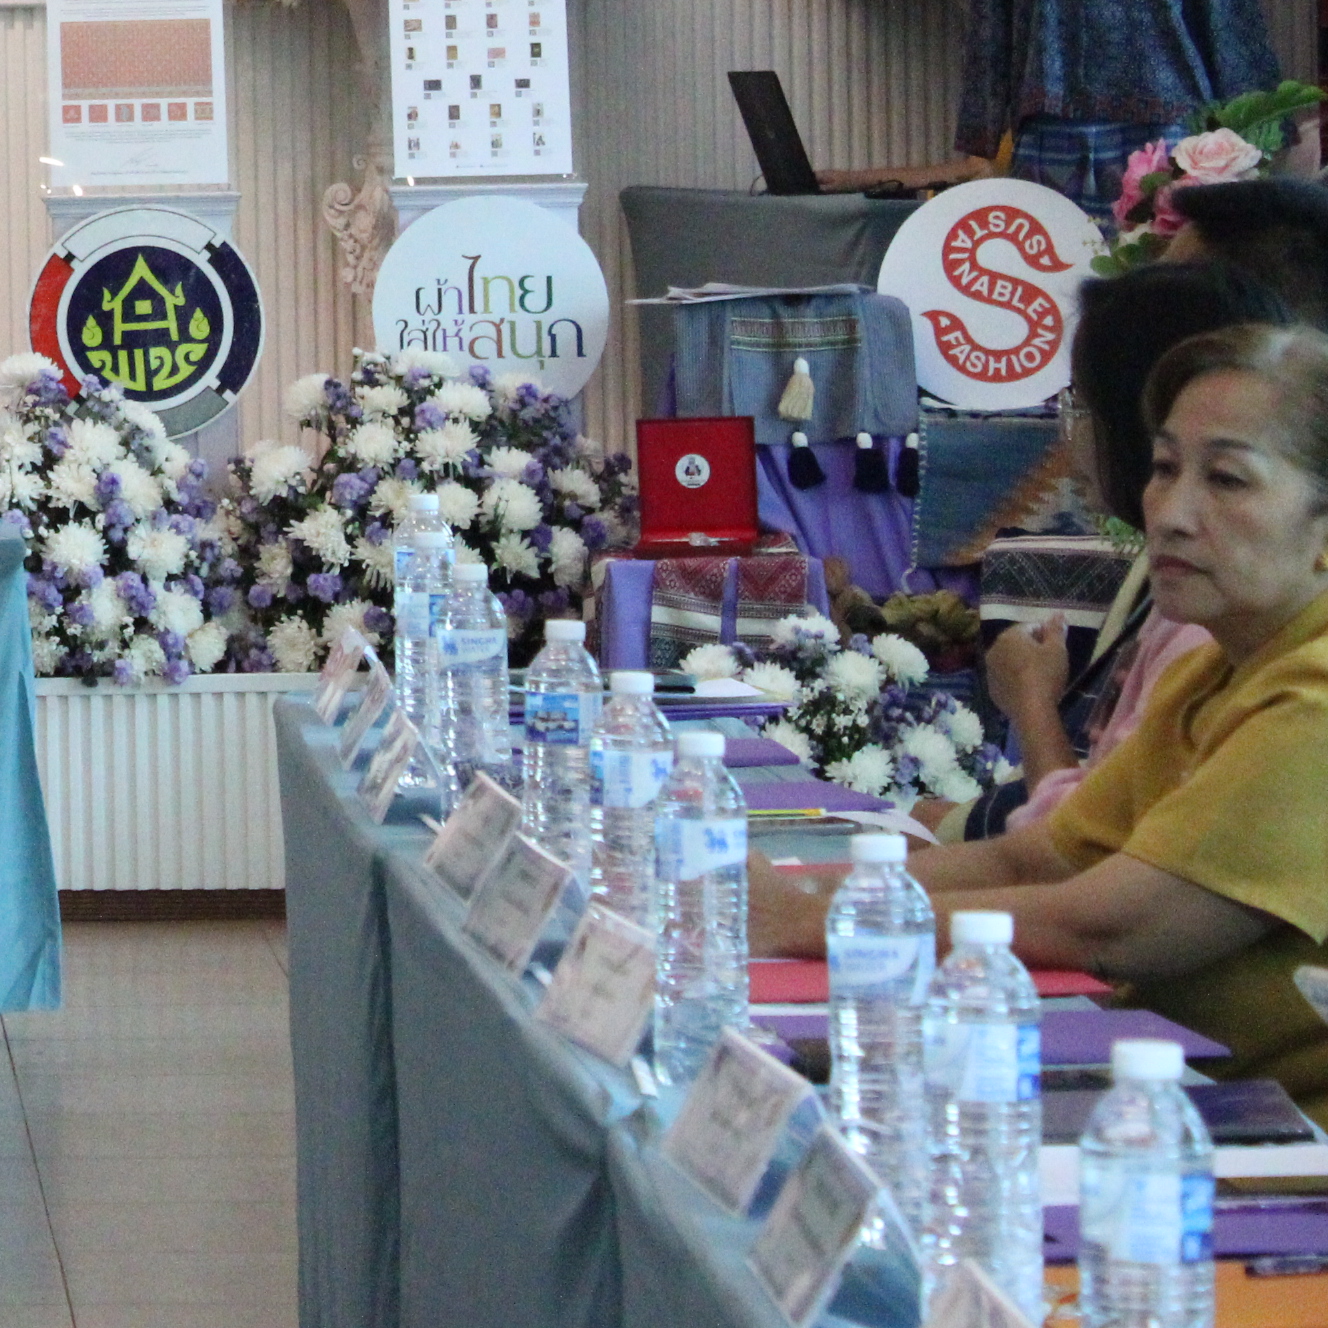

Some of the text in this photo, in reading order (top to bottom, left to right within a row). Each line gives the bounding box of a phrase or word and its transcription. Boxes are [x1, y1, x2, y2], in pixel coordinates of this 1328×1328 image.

[415, 254, 554, 316] ผ้าไทย
[941, 210, 1057, 376] SUSTAINABLE FASHION
[395, 318, 587, 371] ใส่ให้สนุก
